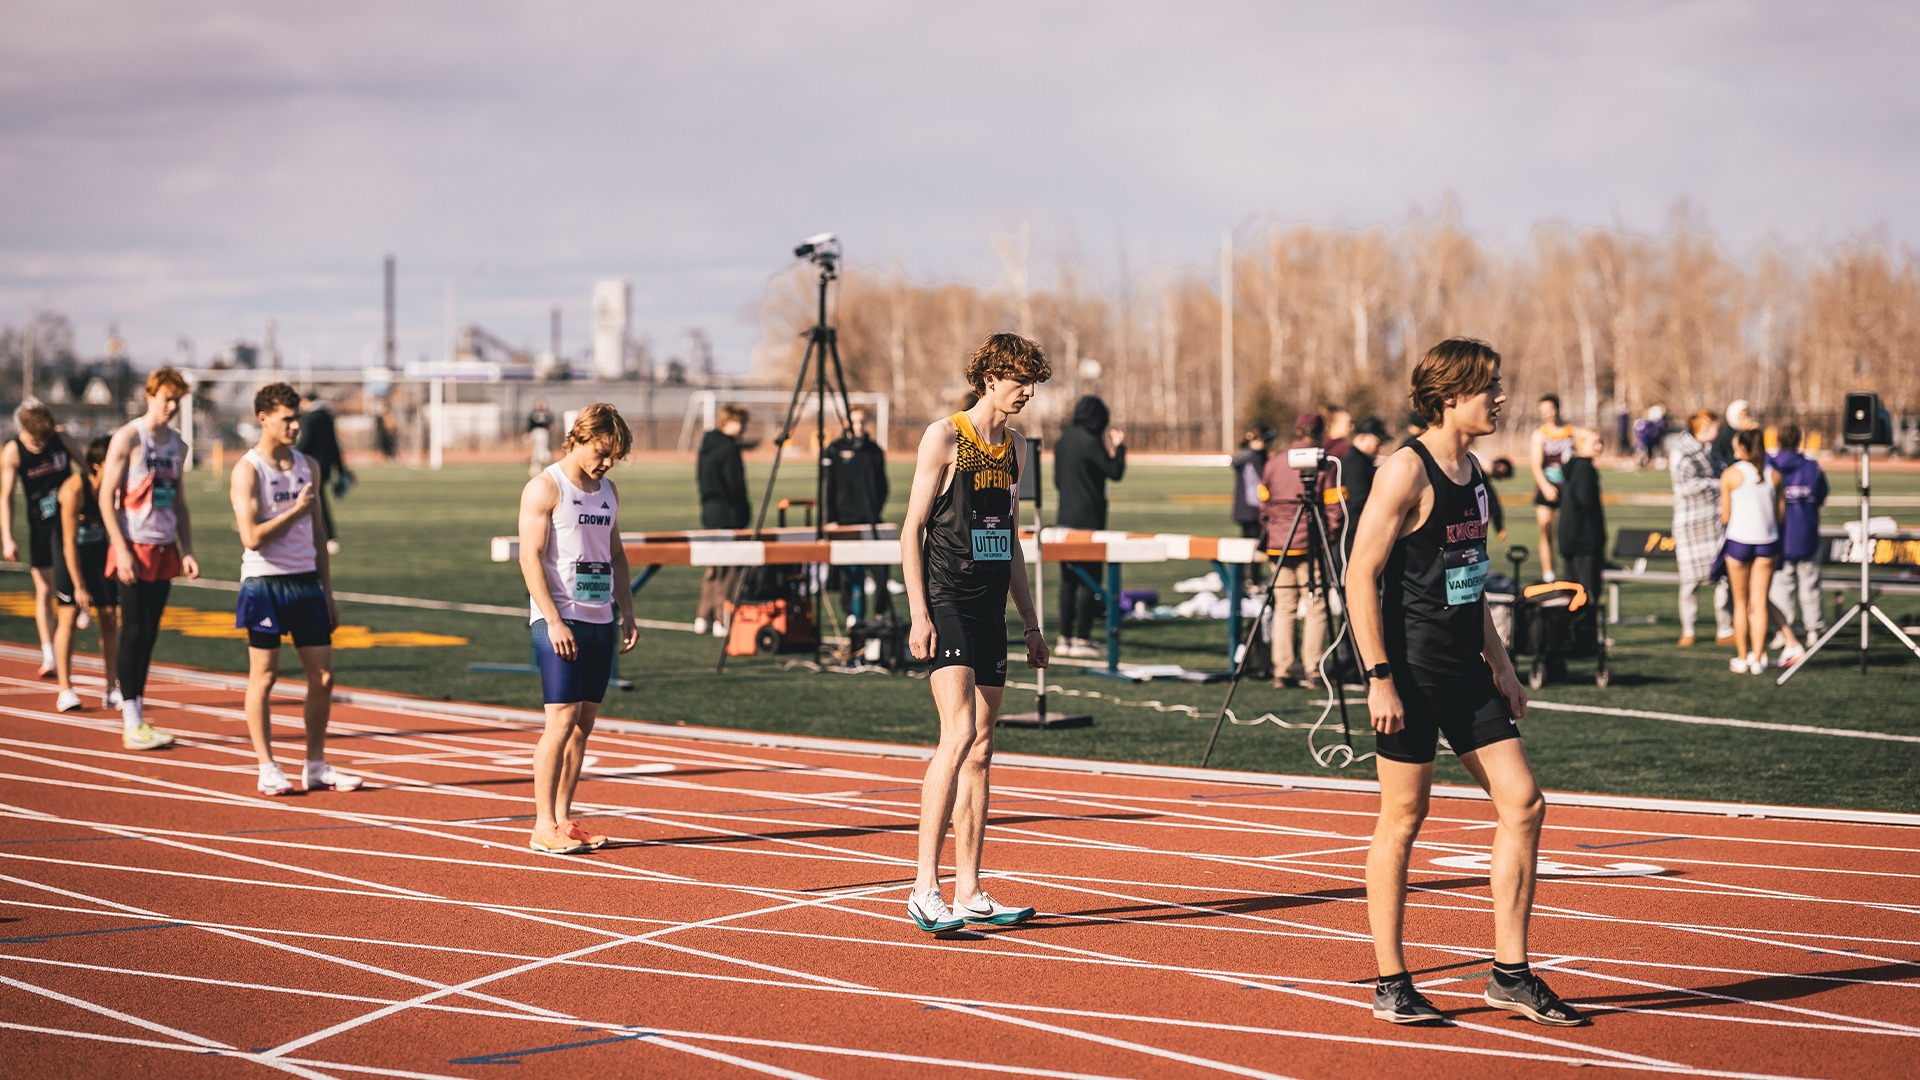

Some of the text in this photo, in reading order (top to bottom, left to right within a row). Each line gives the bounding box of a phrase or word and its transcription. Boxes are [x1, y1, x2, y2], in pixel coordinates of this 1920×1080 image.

[578, 513, 611, 526] CROWN
[974, 535, 1008, 553] UITTO
[576, 581, 611, 592] SWOBODA
